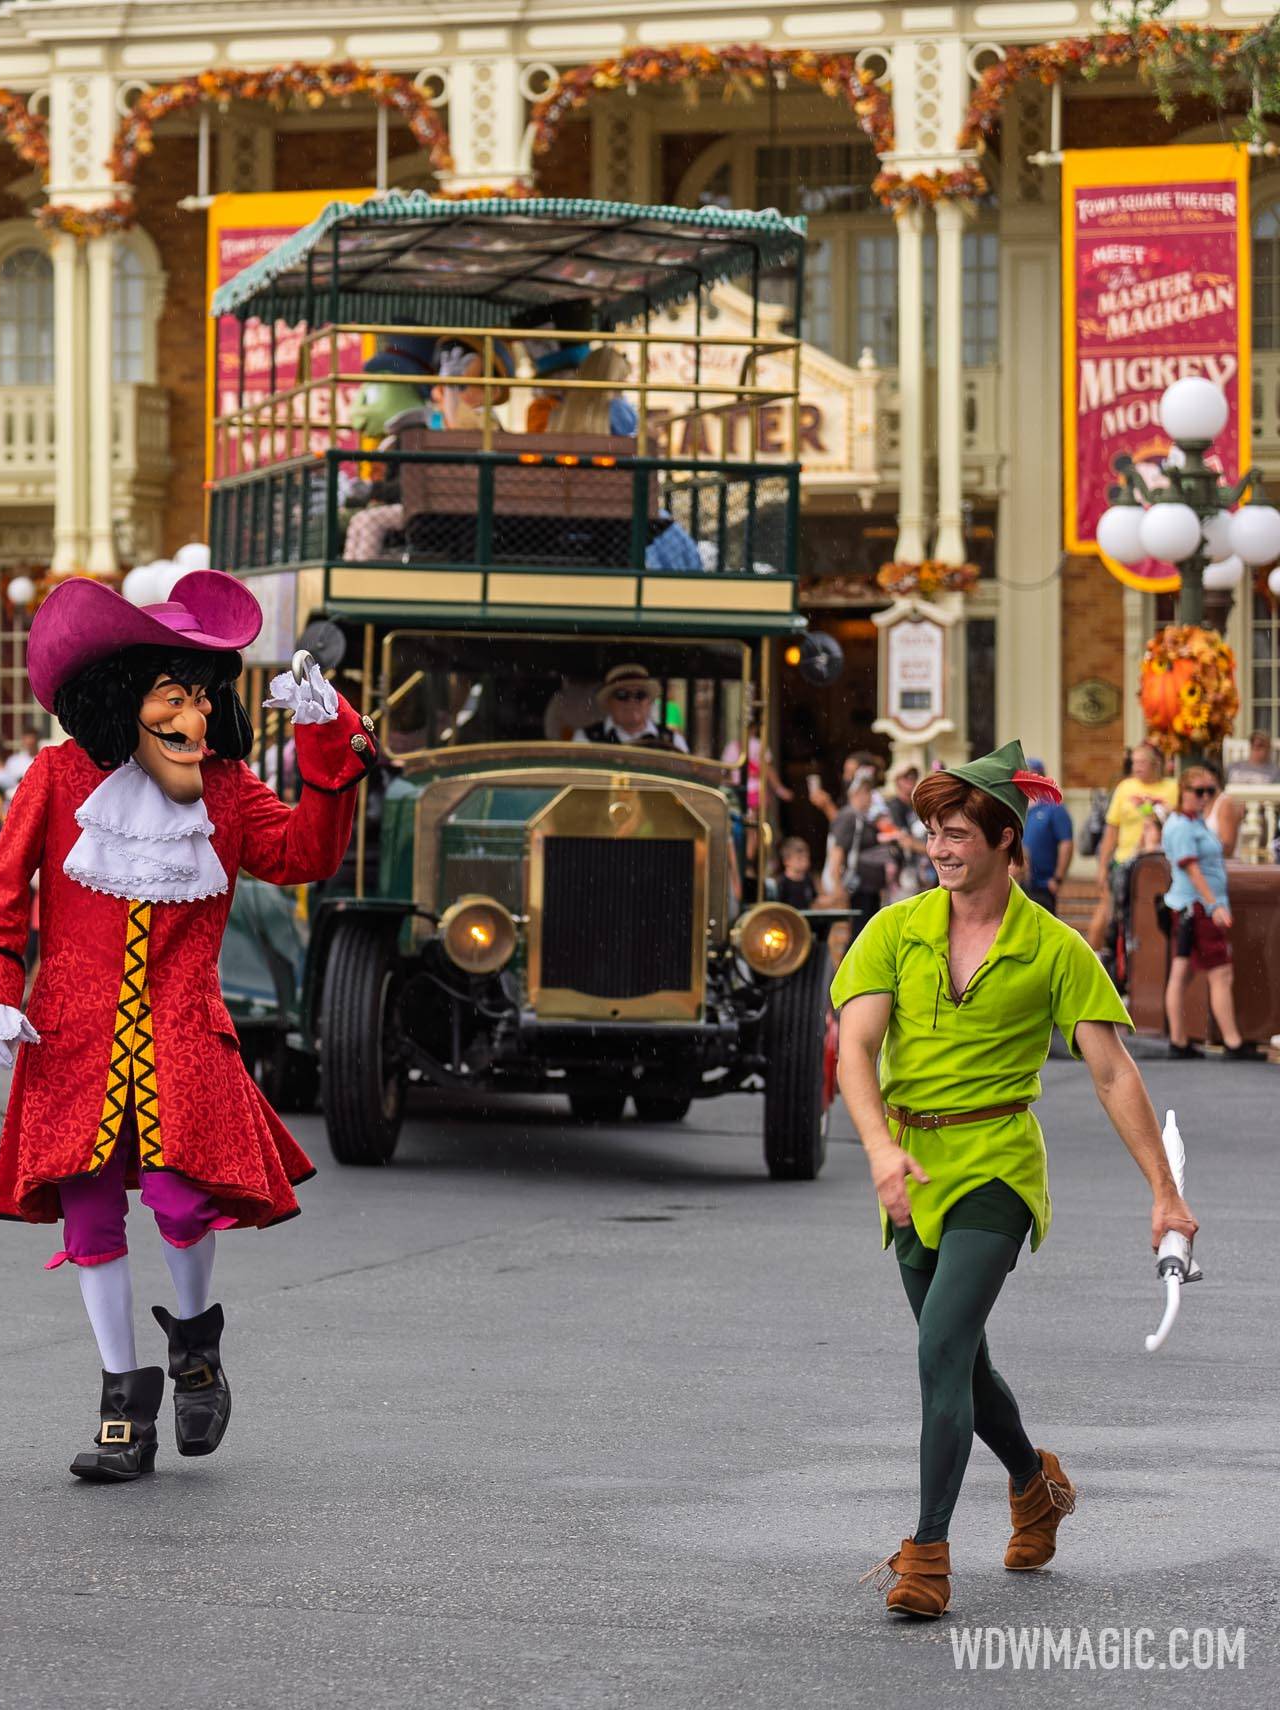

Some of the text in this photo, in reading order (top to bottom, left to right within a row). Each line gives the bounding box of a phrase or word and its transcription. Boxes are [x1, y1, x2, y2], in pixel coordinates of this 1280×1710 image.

[1118, 192, 1171, 212] SQUARE
[1174, 191, 1237, 216] THEATER
[1092, 244, 1146, 267] MEET
[1097, 271, 1193, 317] MASTER
[1106, 283, 1237, 342] MAGICIAN
[1079, 354, 1237, 416] MICKEY
[641, 404, 830, 455] ATER
